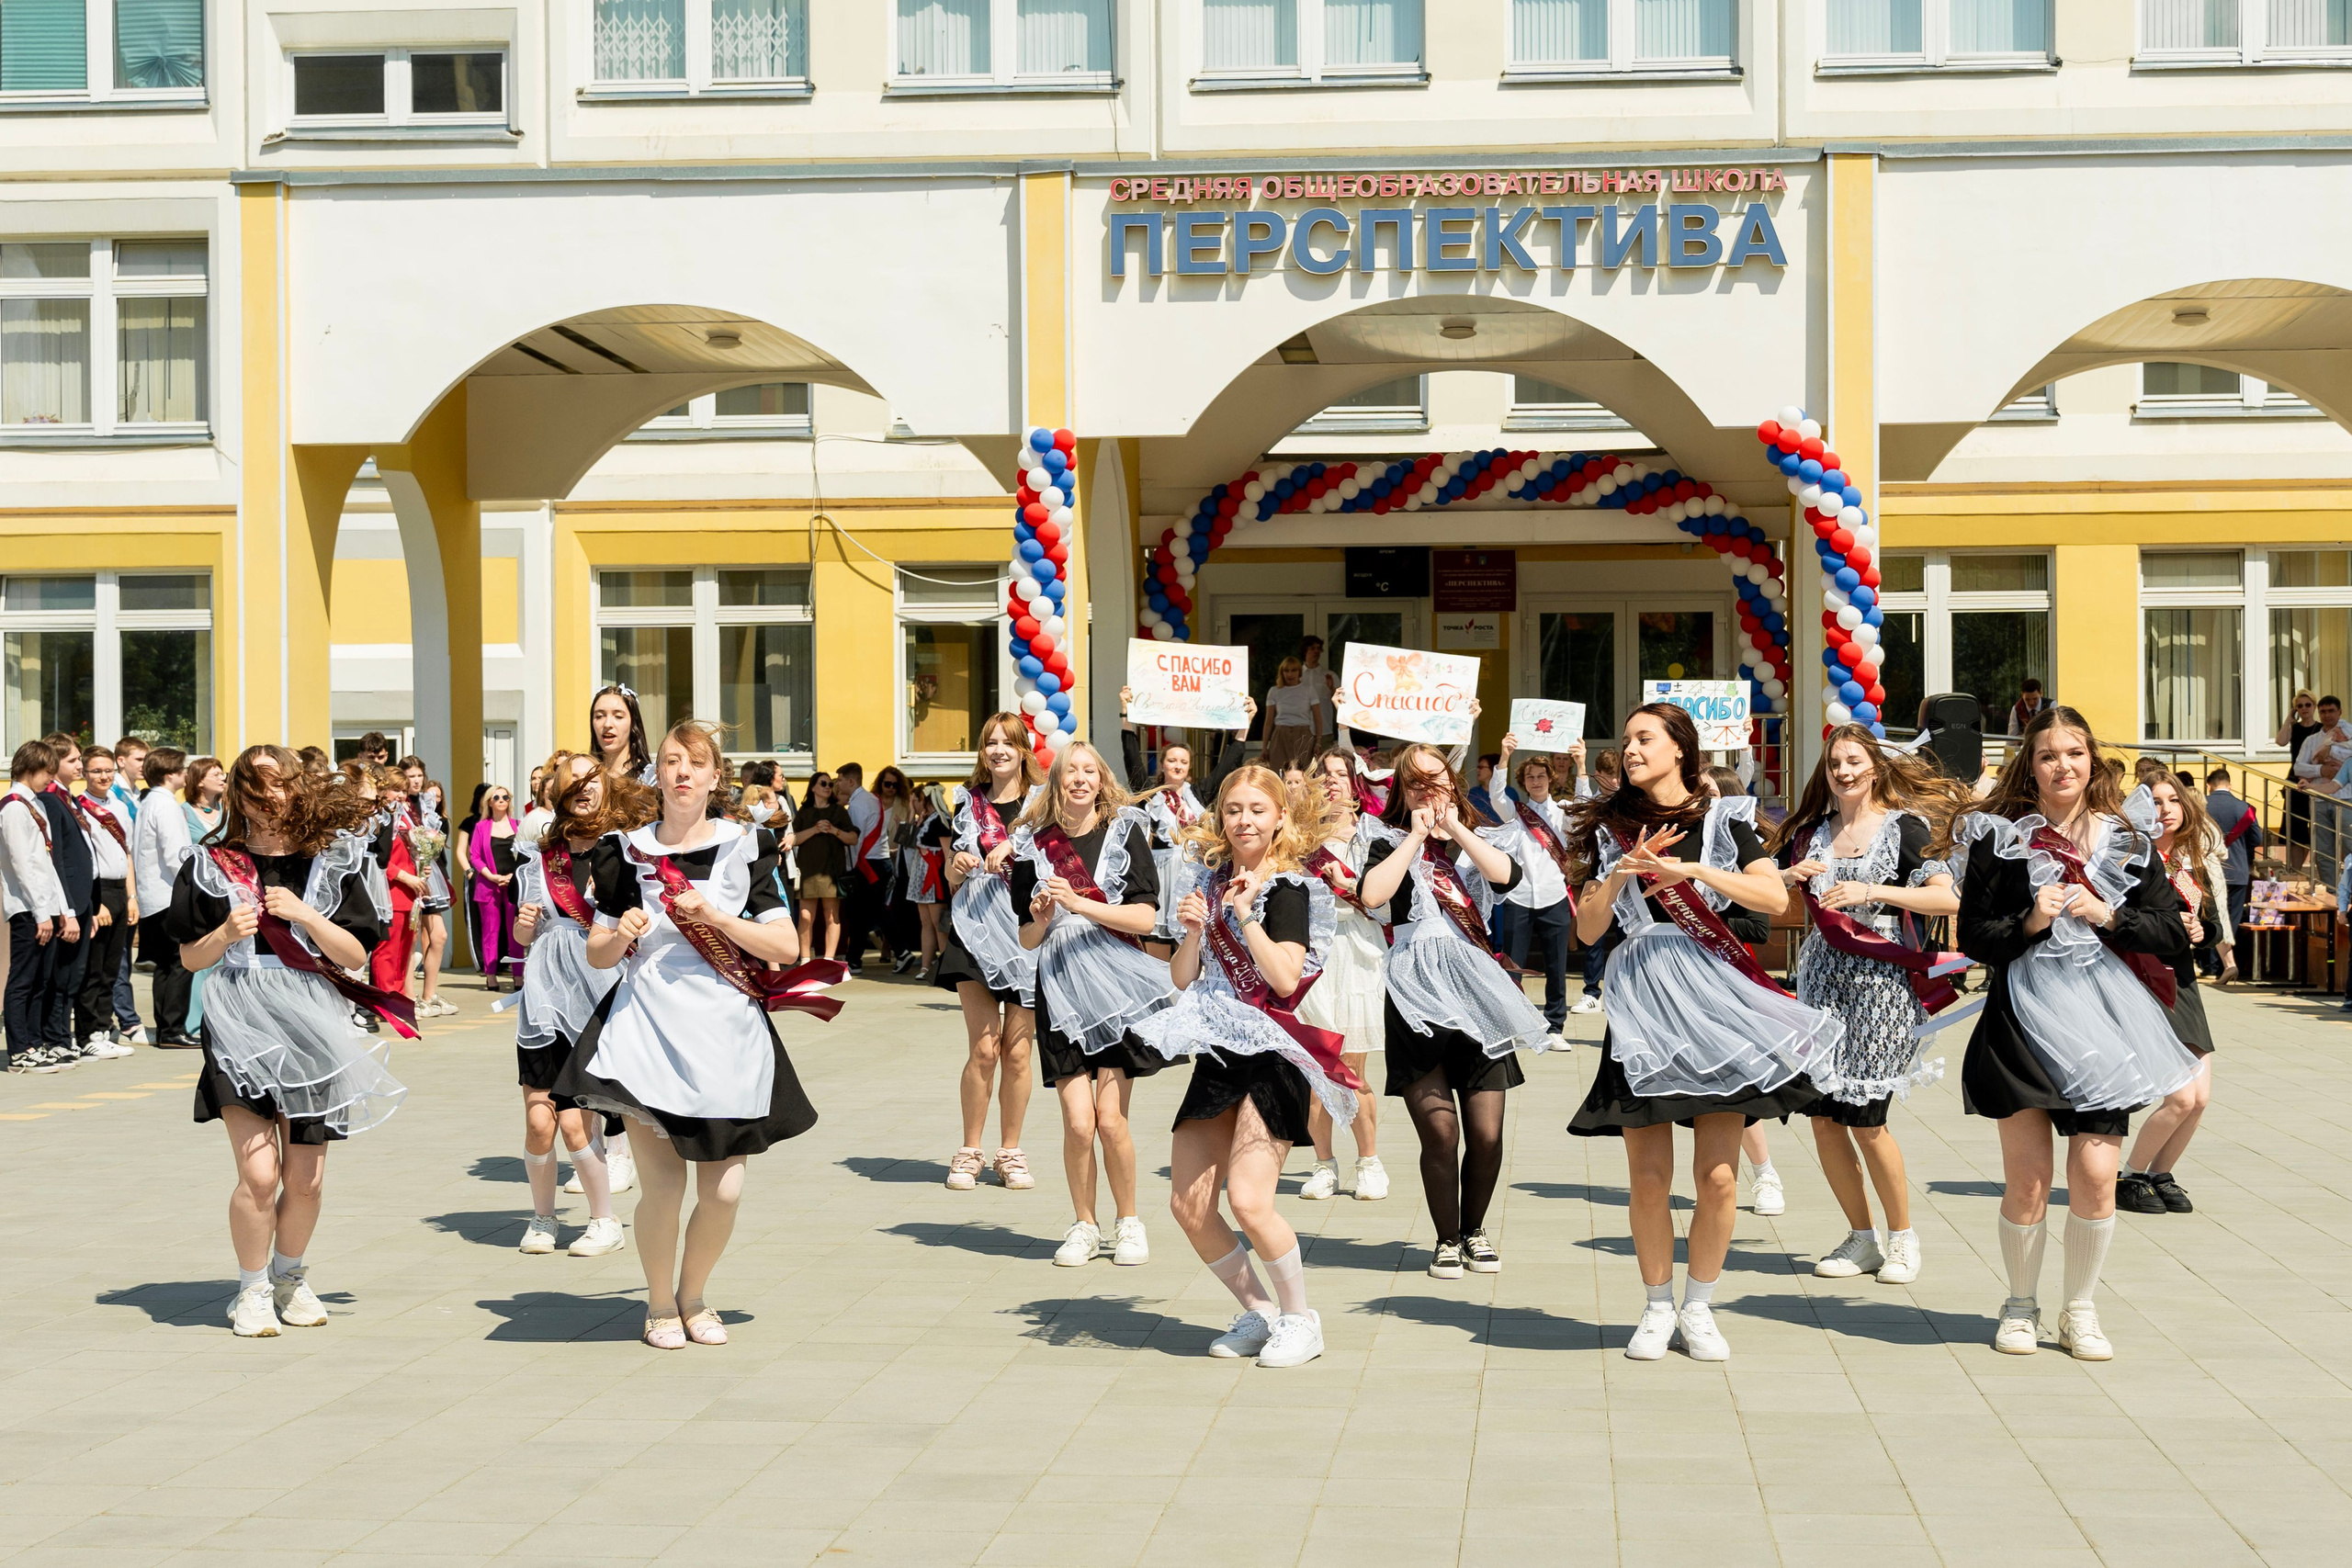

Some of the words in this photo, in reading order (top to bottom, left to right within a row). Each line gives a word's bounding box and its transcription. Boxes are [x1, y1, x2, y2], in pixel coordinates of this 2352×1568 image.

[1109, 175, 1253, 205] СРЕДНЯЯ
[1261, 169, 1662, 202] ОБЩЕОБРАЗОВАТЕЛЬНАЯ
[1671, 168, 1789, 193] ШКОЛА
[1109, 202, 1789, 277] ПЕРСПЕКТИВА
[1157, 654, 1232, 676] СПАСИБО
[1171, 674, 1201, 693] ВАМ
[1353, 671, 1463, 713] Спасибо
[1234, 962, 1261, 993] 2025
